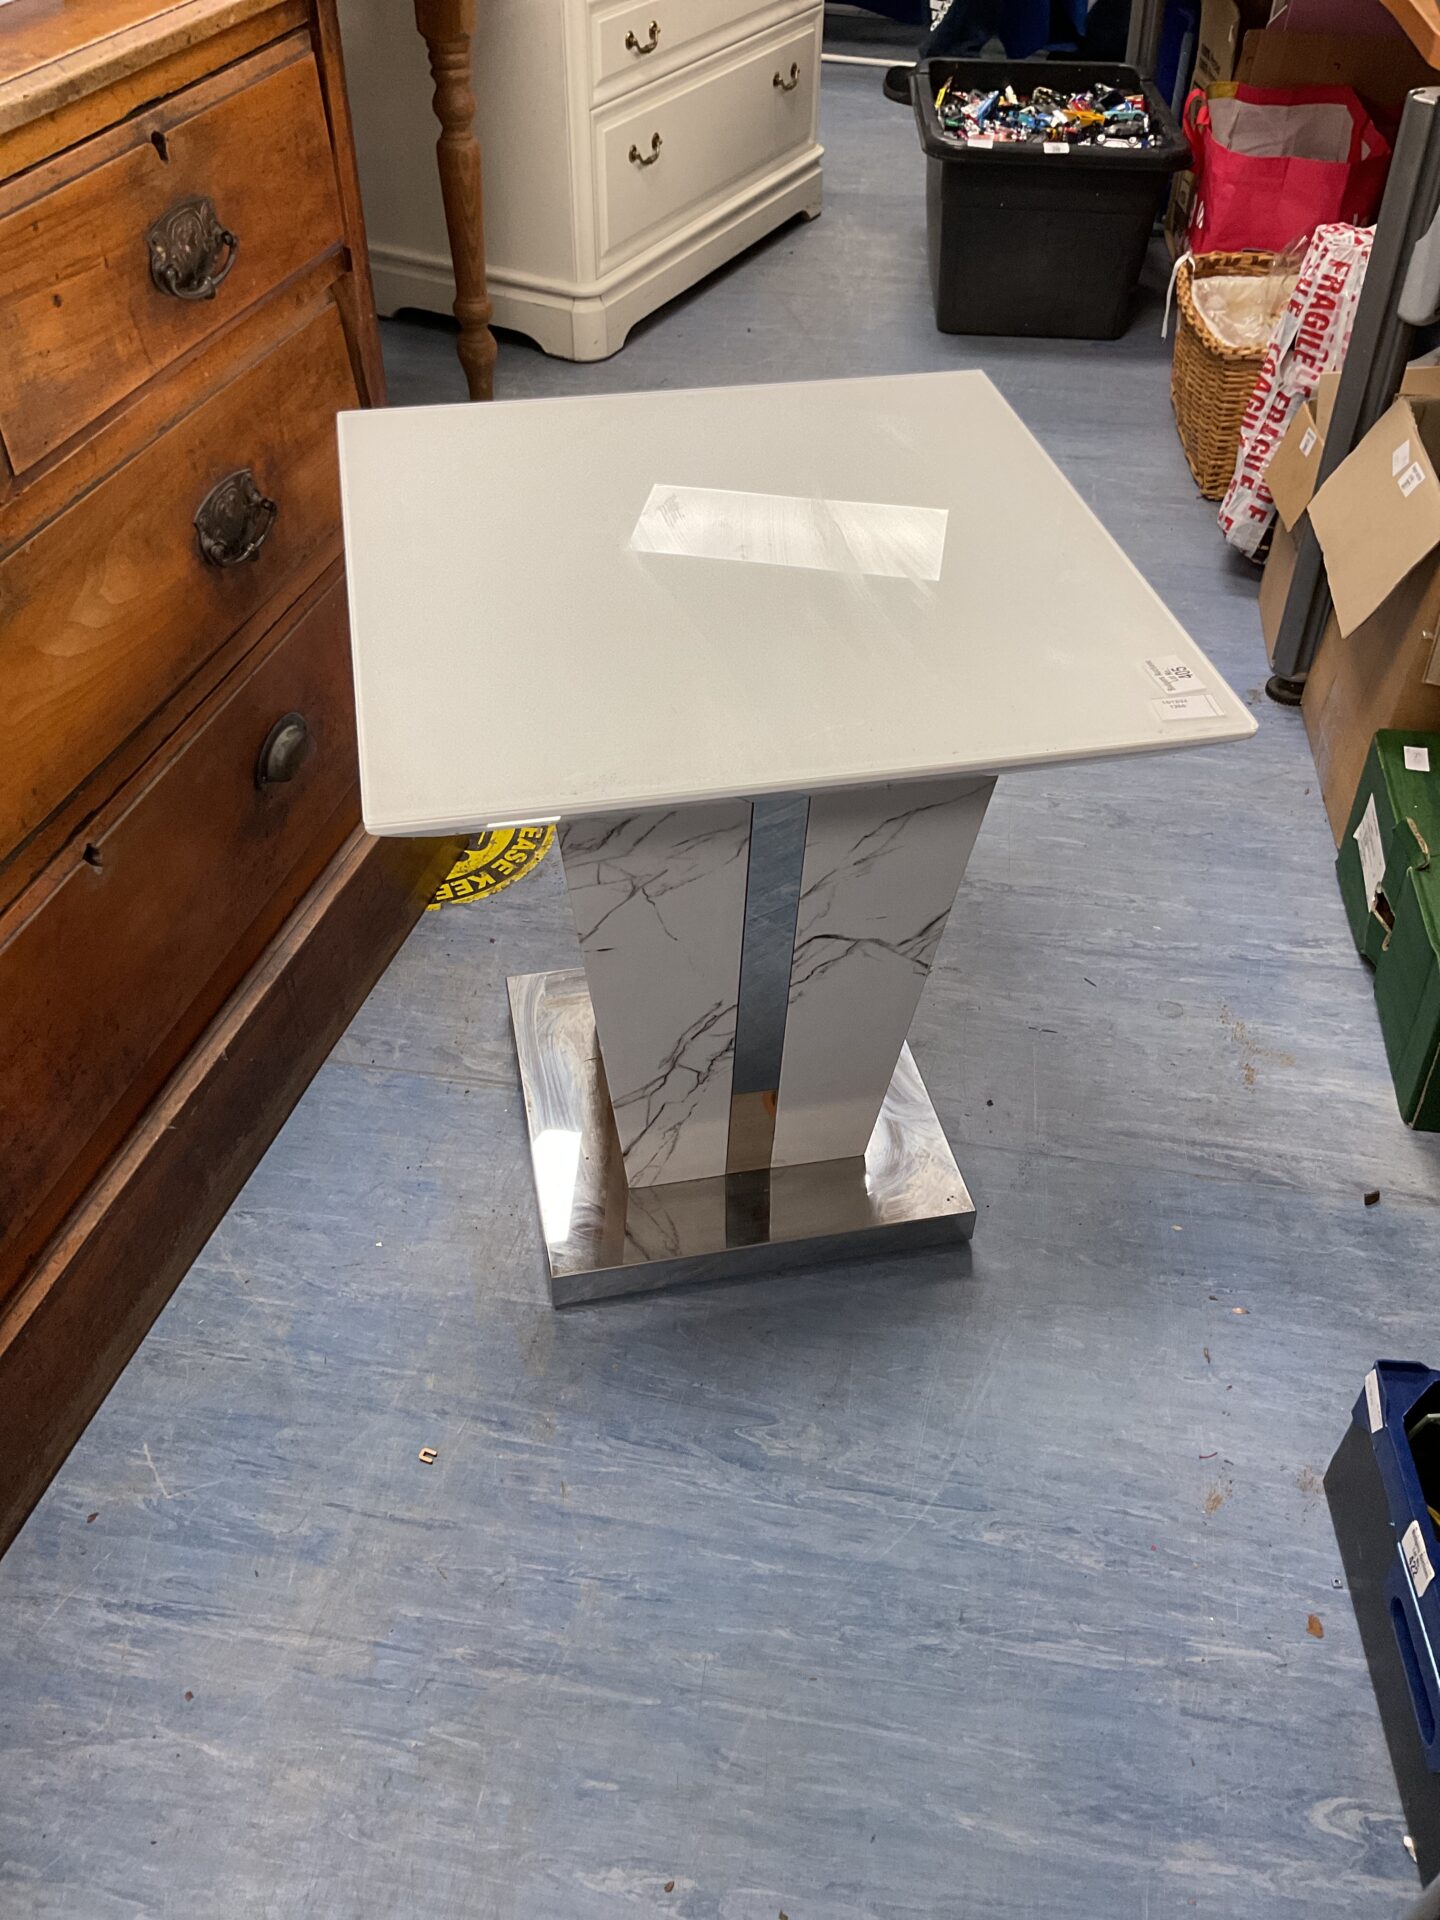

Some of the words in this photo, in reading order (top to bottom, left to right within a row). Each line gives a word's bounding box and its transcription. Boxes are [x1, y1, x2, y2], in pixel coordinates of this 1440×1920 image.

[1293, 258, 1351, 369] FRAGILE
[1170, 666, 1192, 679] 405
[491, 827, 543, 875] EASE
[436, 871, 496, 901] KEE
